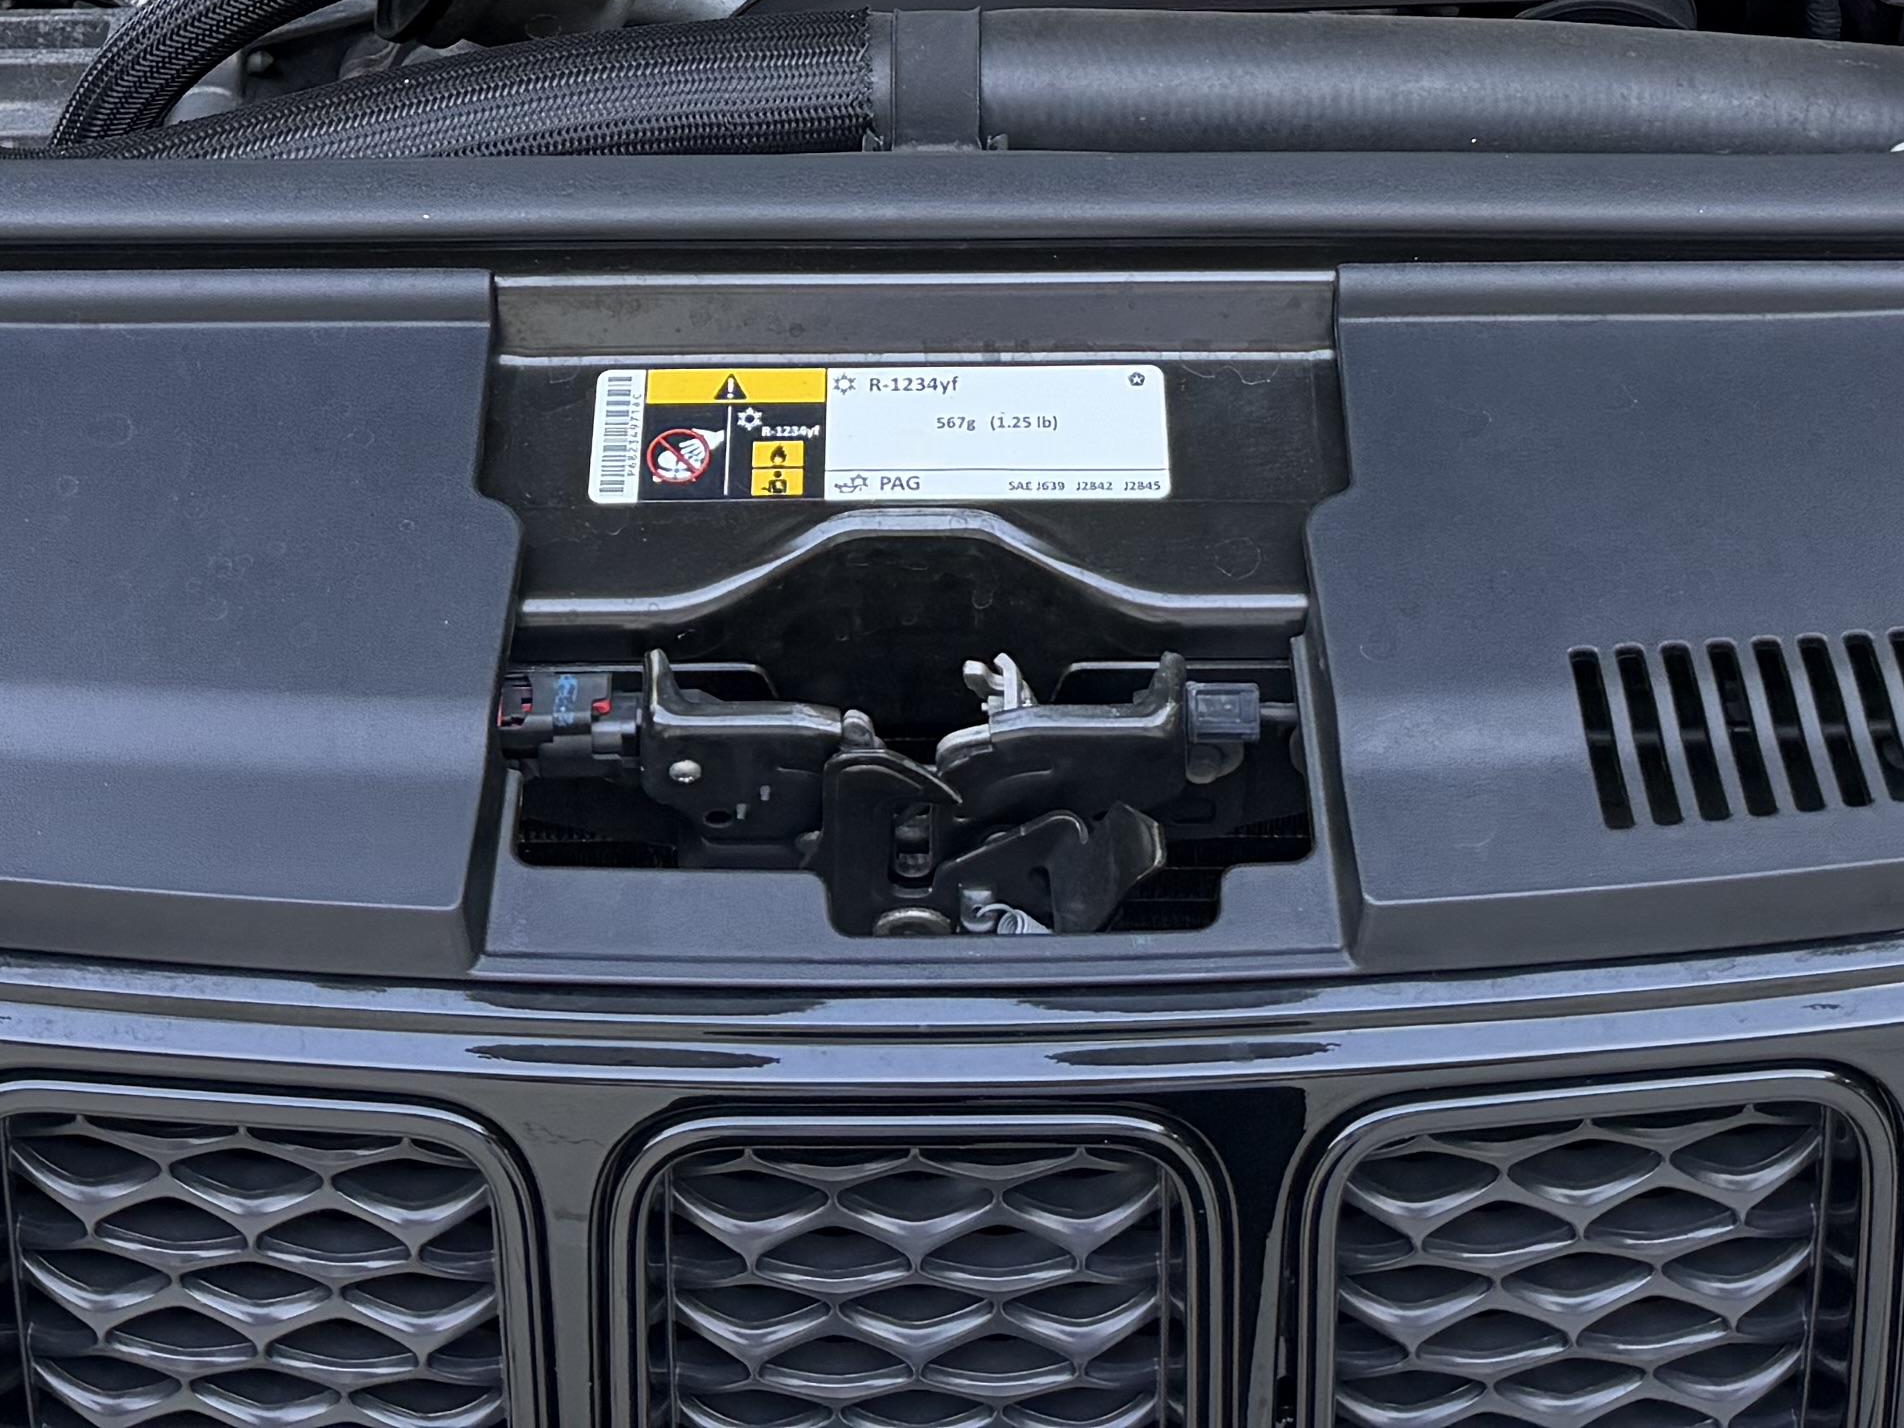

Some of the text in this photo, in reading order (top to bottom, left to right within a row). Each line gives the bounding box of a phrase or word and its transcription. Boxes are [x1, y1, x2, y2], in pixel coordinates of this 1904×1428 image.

[868, 375, 959, 394] R-1234yf
[936, 415, 1058, 431] 567g (1.25 lb)
[761, 424, 821, 440] R-1234yf
[879, 475, 921, 491] PAG
[1008, 480, 1161, 491] SAE J639 J2842 J2845
